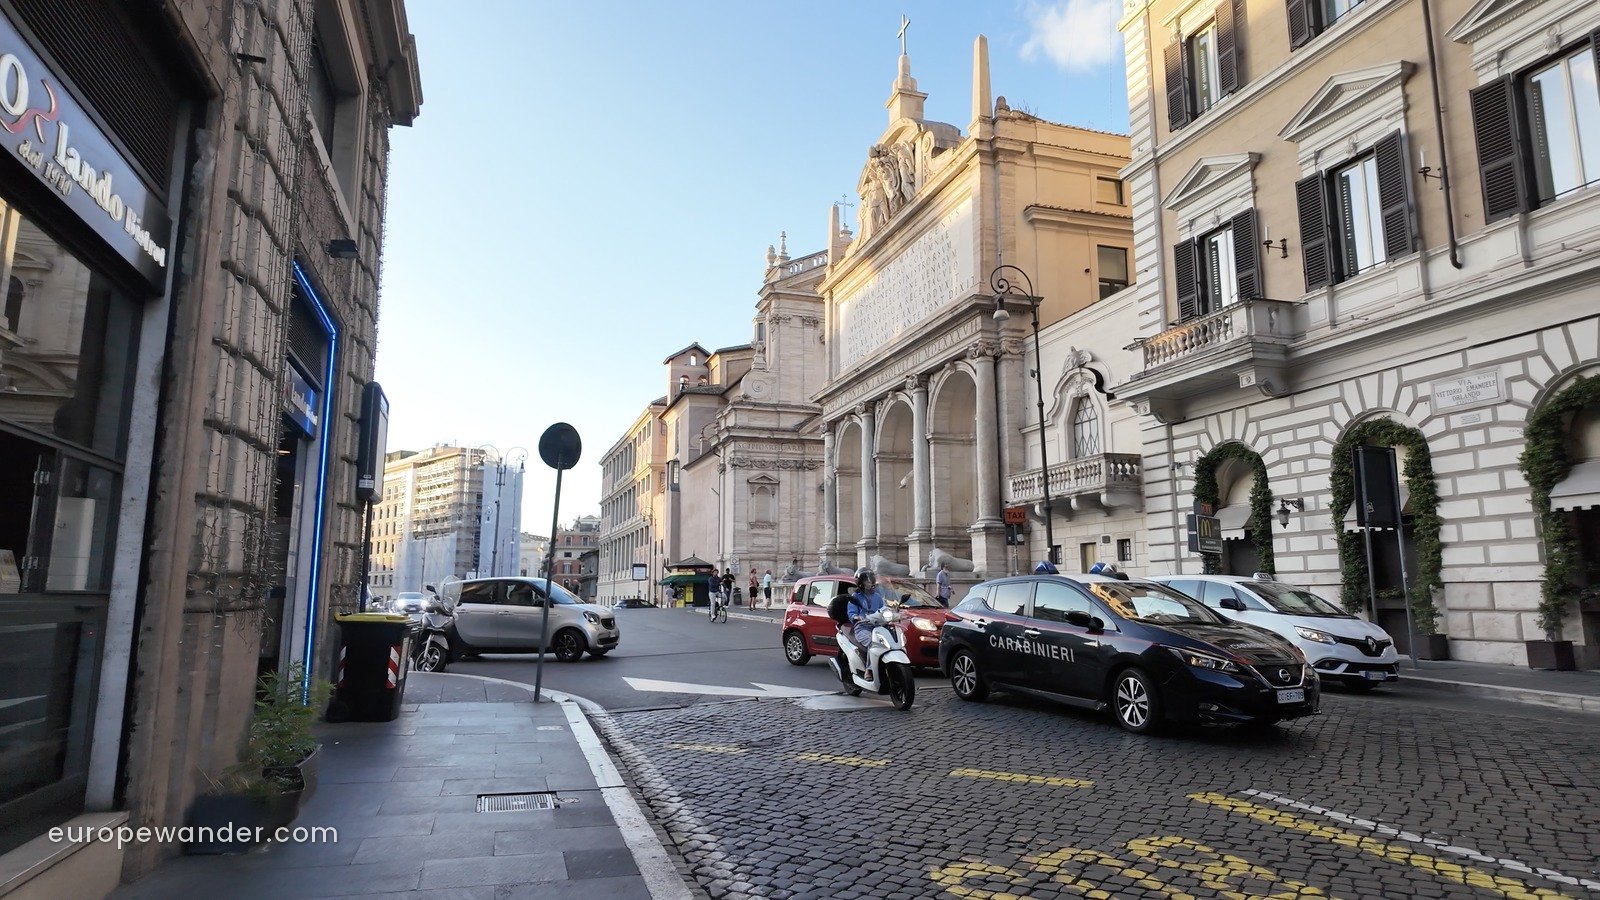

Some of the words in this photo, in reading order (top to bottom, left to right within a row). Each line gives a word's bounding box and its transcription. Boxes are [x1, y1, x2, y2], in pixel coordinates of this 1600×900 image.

[18, 139, 43, 169] dal
[1436, 387, 1462, 398] VITTORIO
[1466, 380, 1497, 392] EMANUELE
[1452, 391, 1481, 401] ORLANDO
[989, 634, 1075, 663] CARABINIERI
